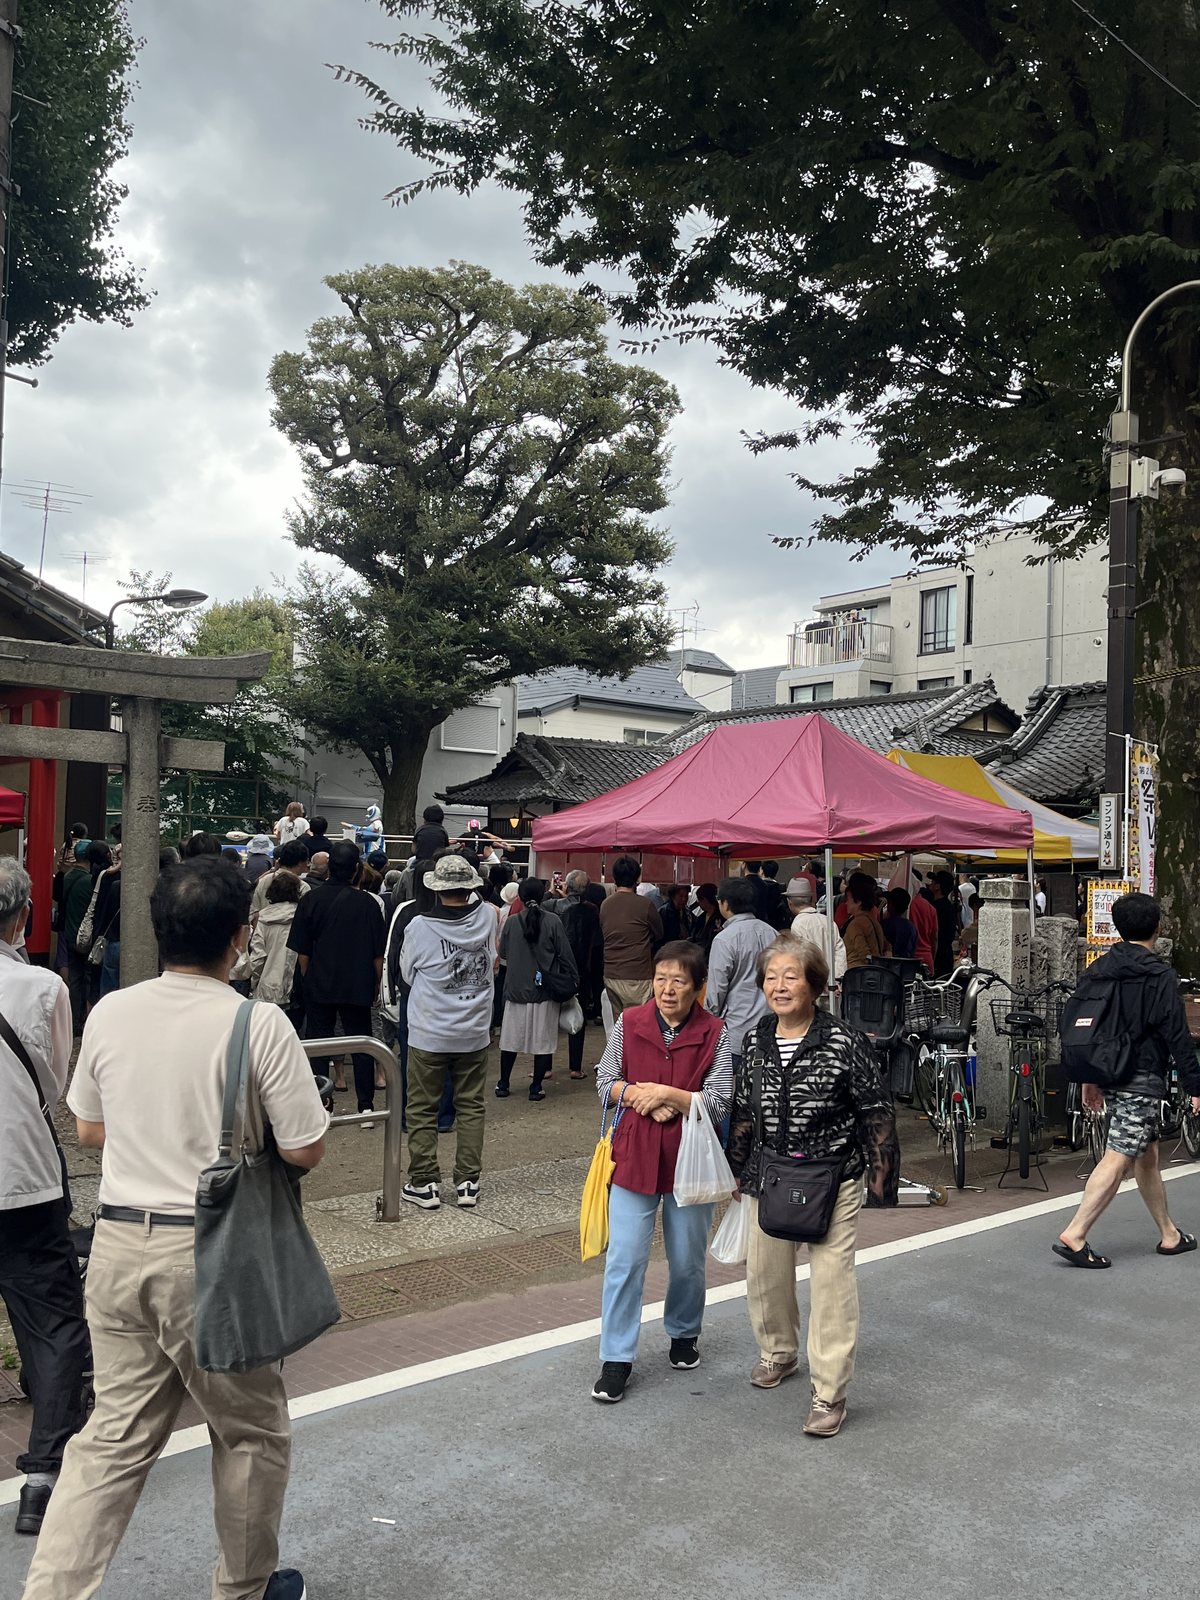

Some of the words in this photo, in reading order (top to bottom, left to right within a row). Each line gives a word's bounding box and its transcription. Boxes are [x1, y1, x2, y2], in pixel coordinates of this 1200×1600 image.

[137, 795, 157, 812] 奉
[1103, 800, 1112, 849] コンコン通り
